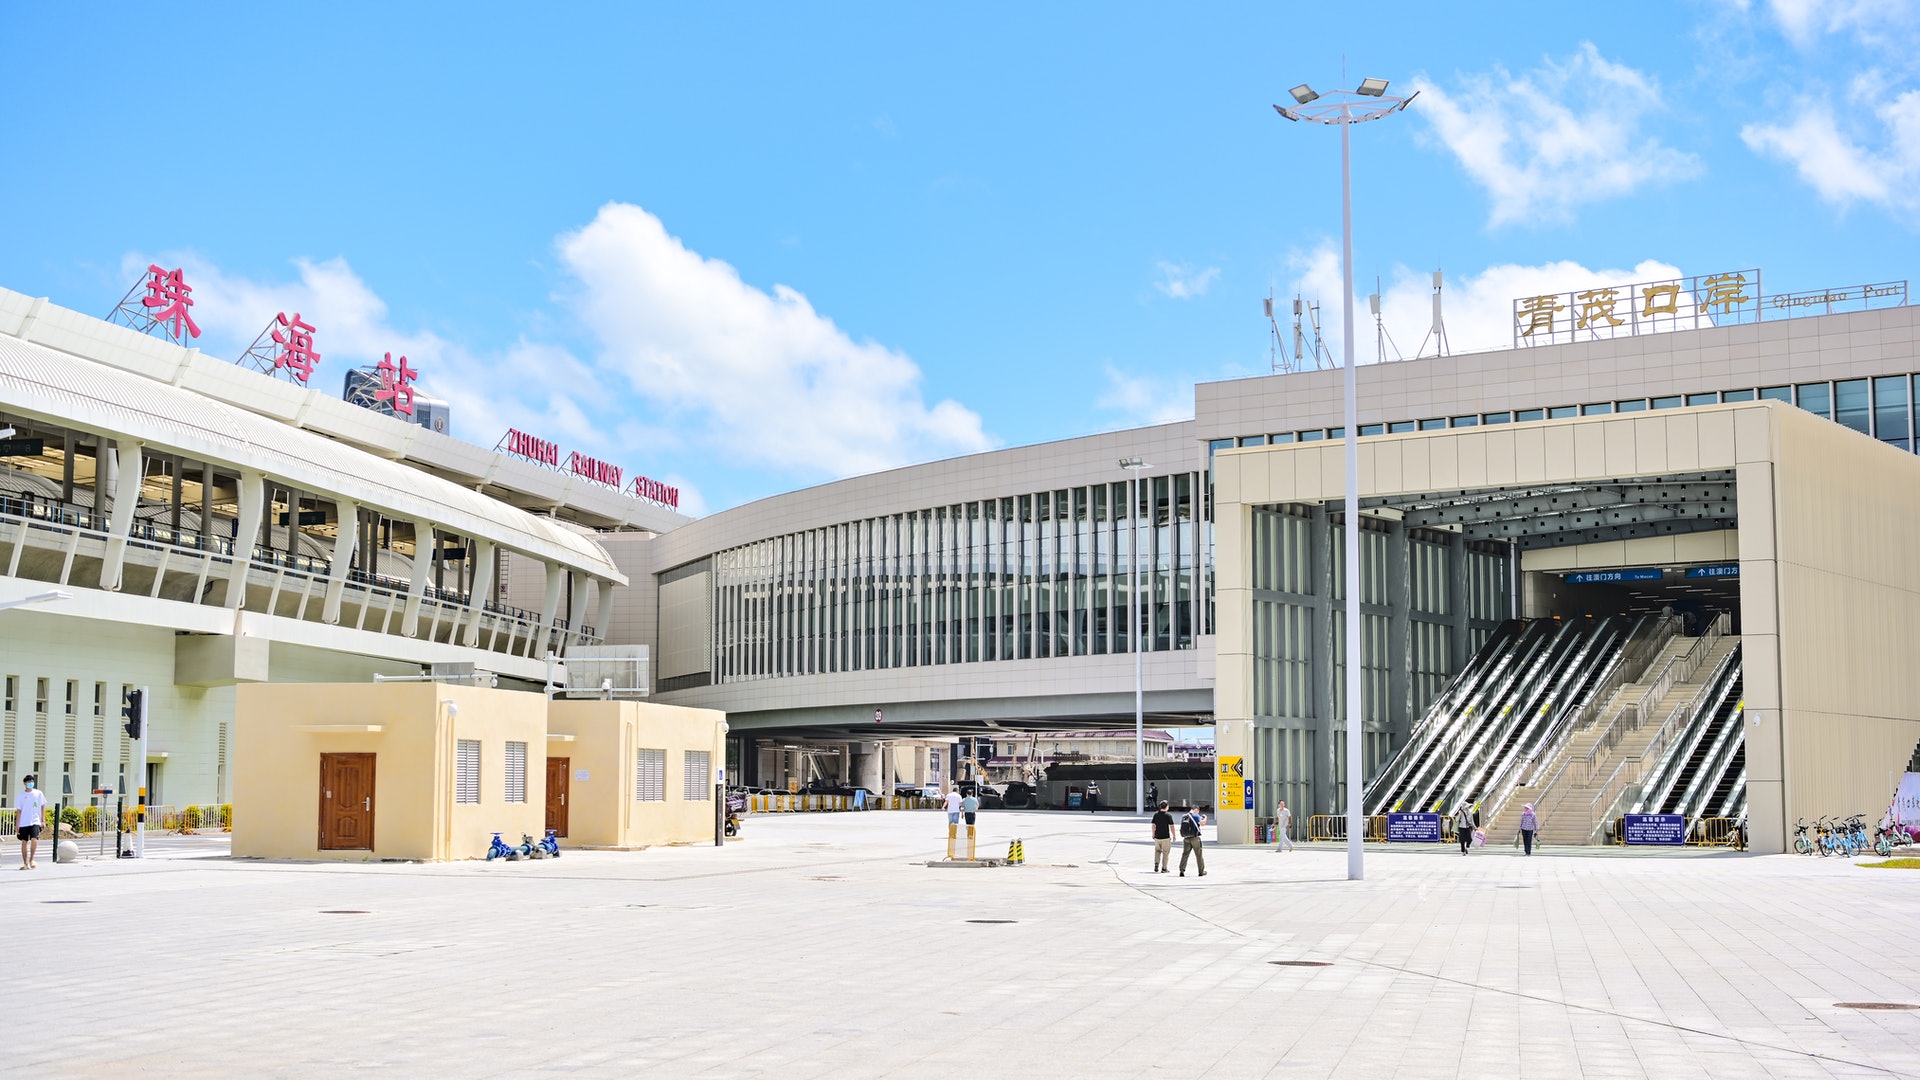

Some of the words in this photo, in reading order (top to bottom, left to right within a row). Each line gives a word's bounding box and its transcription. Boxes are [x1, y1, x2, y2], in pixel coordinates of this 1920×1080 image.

[1517, 272, 1748, 336] 青茂口岸
[1773, 292, 1848, 310] Qingmao
[1863, 285, 1900, 298] Port
[142, 264, 418, 416] 珠海站
[508, 427, 559, 466] ZHUHAI
[571, 450, 624, 488] RAILWAY
[635, 475, 679, 508] STATION
[1585, 572, 1622, 582] 往澳门方向
